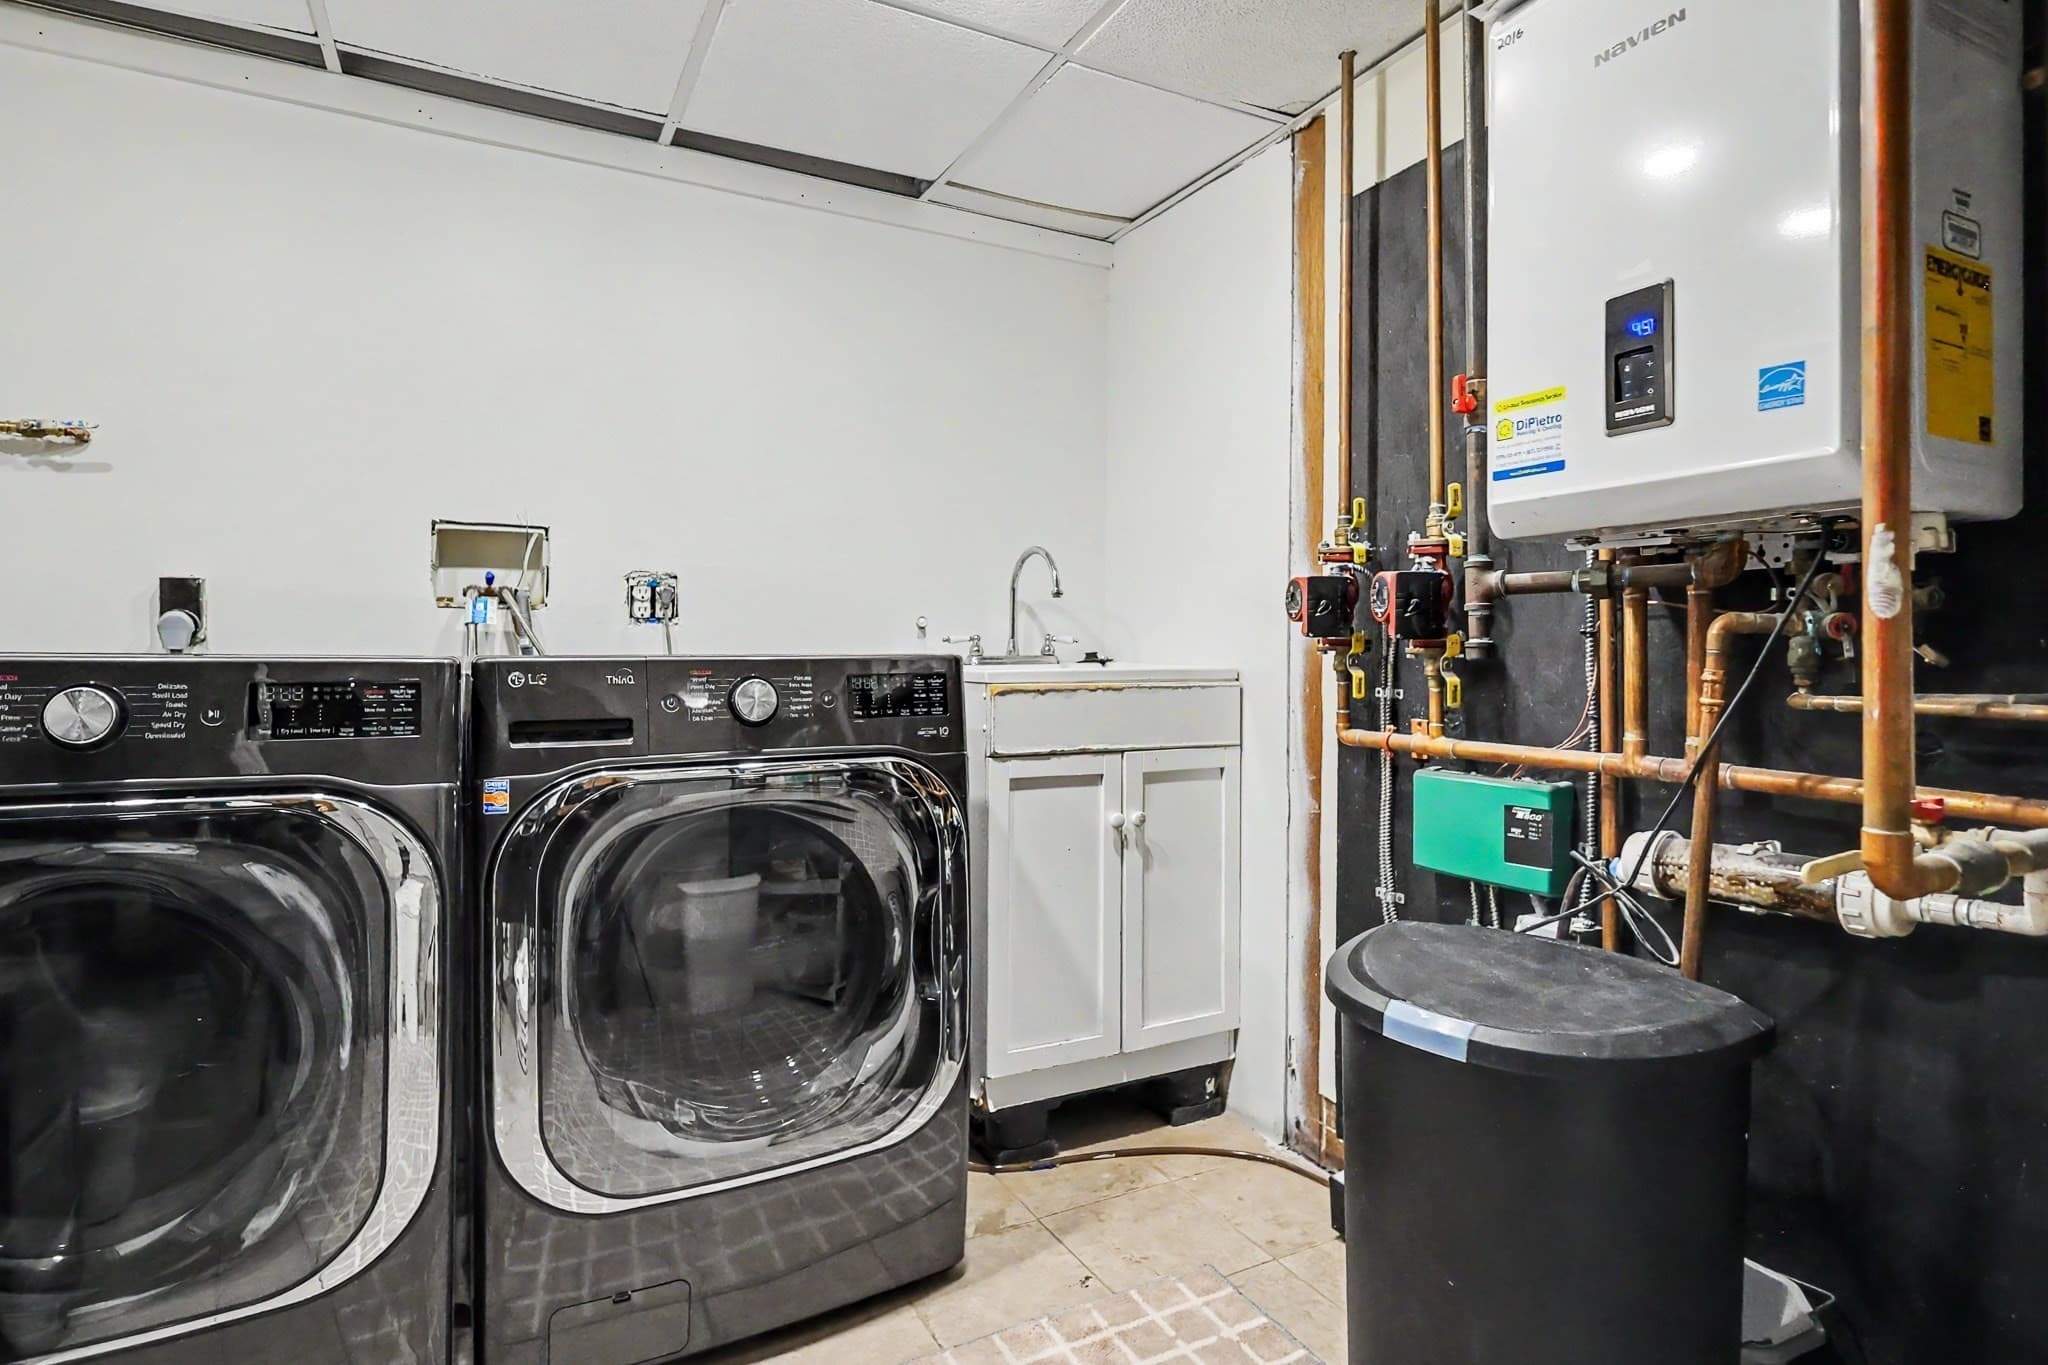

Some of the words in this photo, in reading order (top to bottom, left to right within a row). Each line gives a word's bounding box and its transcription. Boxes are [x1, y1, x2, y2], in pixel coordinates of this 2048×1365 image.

[1497, 28, 1524, 50] 2016
[1516, 414, 1562, 431] DiPietro
[528, 673, 547, 686] LG
[605, 673, 635, 686] ThinQ
[174, 710, 187, 719] Dry
[173, 721, 186, 730] Dry
